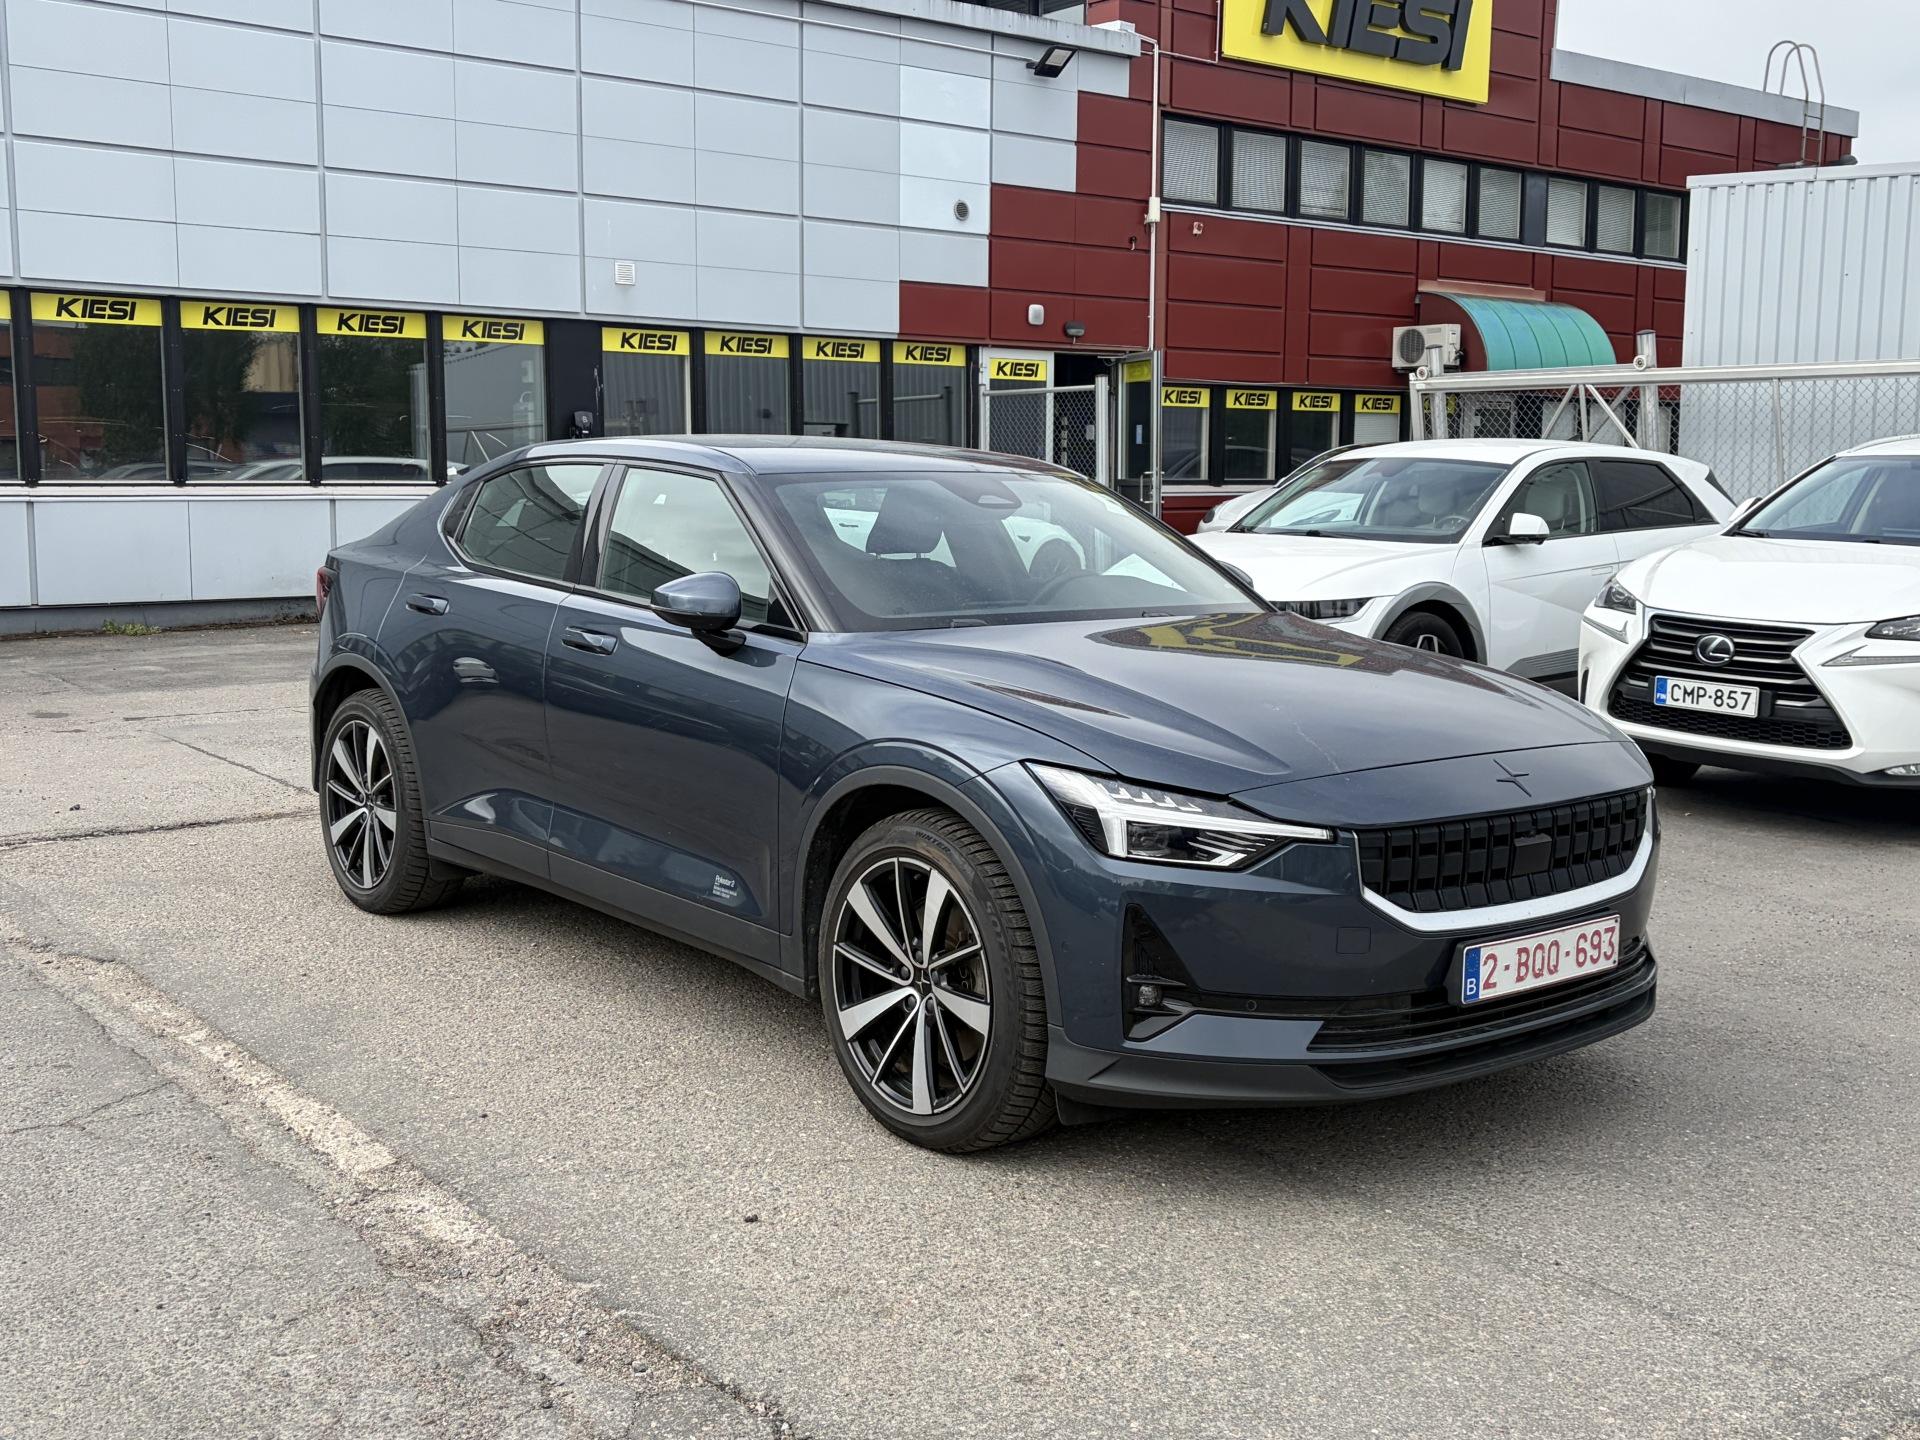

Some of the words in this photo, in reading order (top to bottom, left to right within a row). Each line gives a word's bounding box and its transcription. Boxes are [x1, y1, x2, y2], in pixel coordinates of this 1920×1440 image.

[56, 297, 137, 321] KIESI
[203, 306, 276, 328] KIESI
[337, 312, 405, 334] KIESI
[462, 320, 525, 341] KIESI
[620, 332, 678, 352] KIESI
[719, 335, 773, 355] KIESI
[815, 341, 866, 359] KIESI
[905, 345, 952, 363] KIESI
[996, 361, 1040, 378] KIESI
[1163, 389, 1202, 405] KIESI
[1233, 392, 1270, 407] KIESI
[1298, 395, 1333, 409] KIESI
[1361, 397, 1394, 411] KIESI
[1671, 683, 1752, 711] CMP-857
[1482, 925, 1617, 991] 2-BQQ-693
[1466, 977, 1477, 996] B
